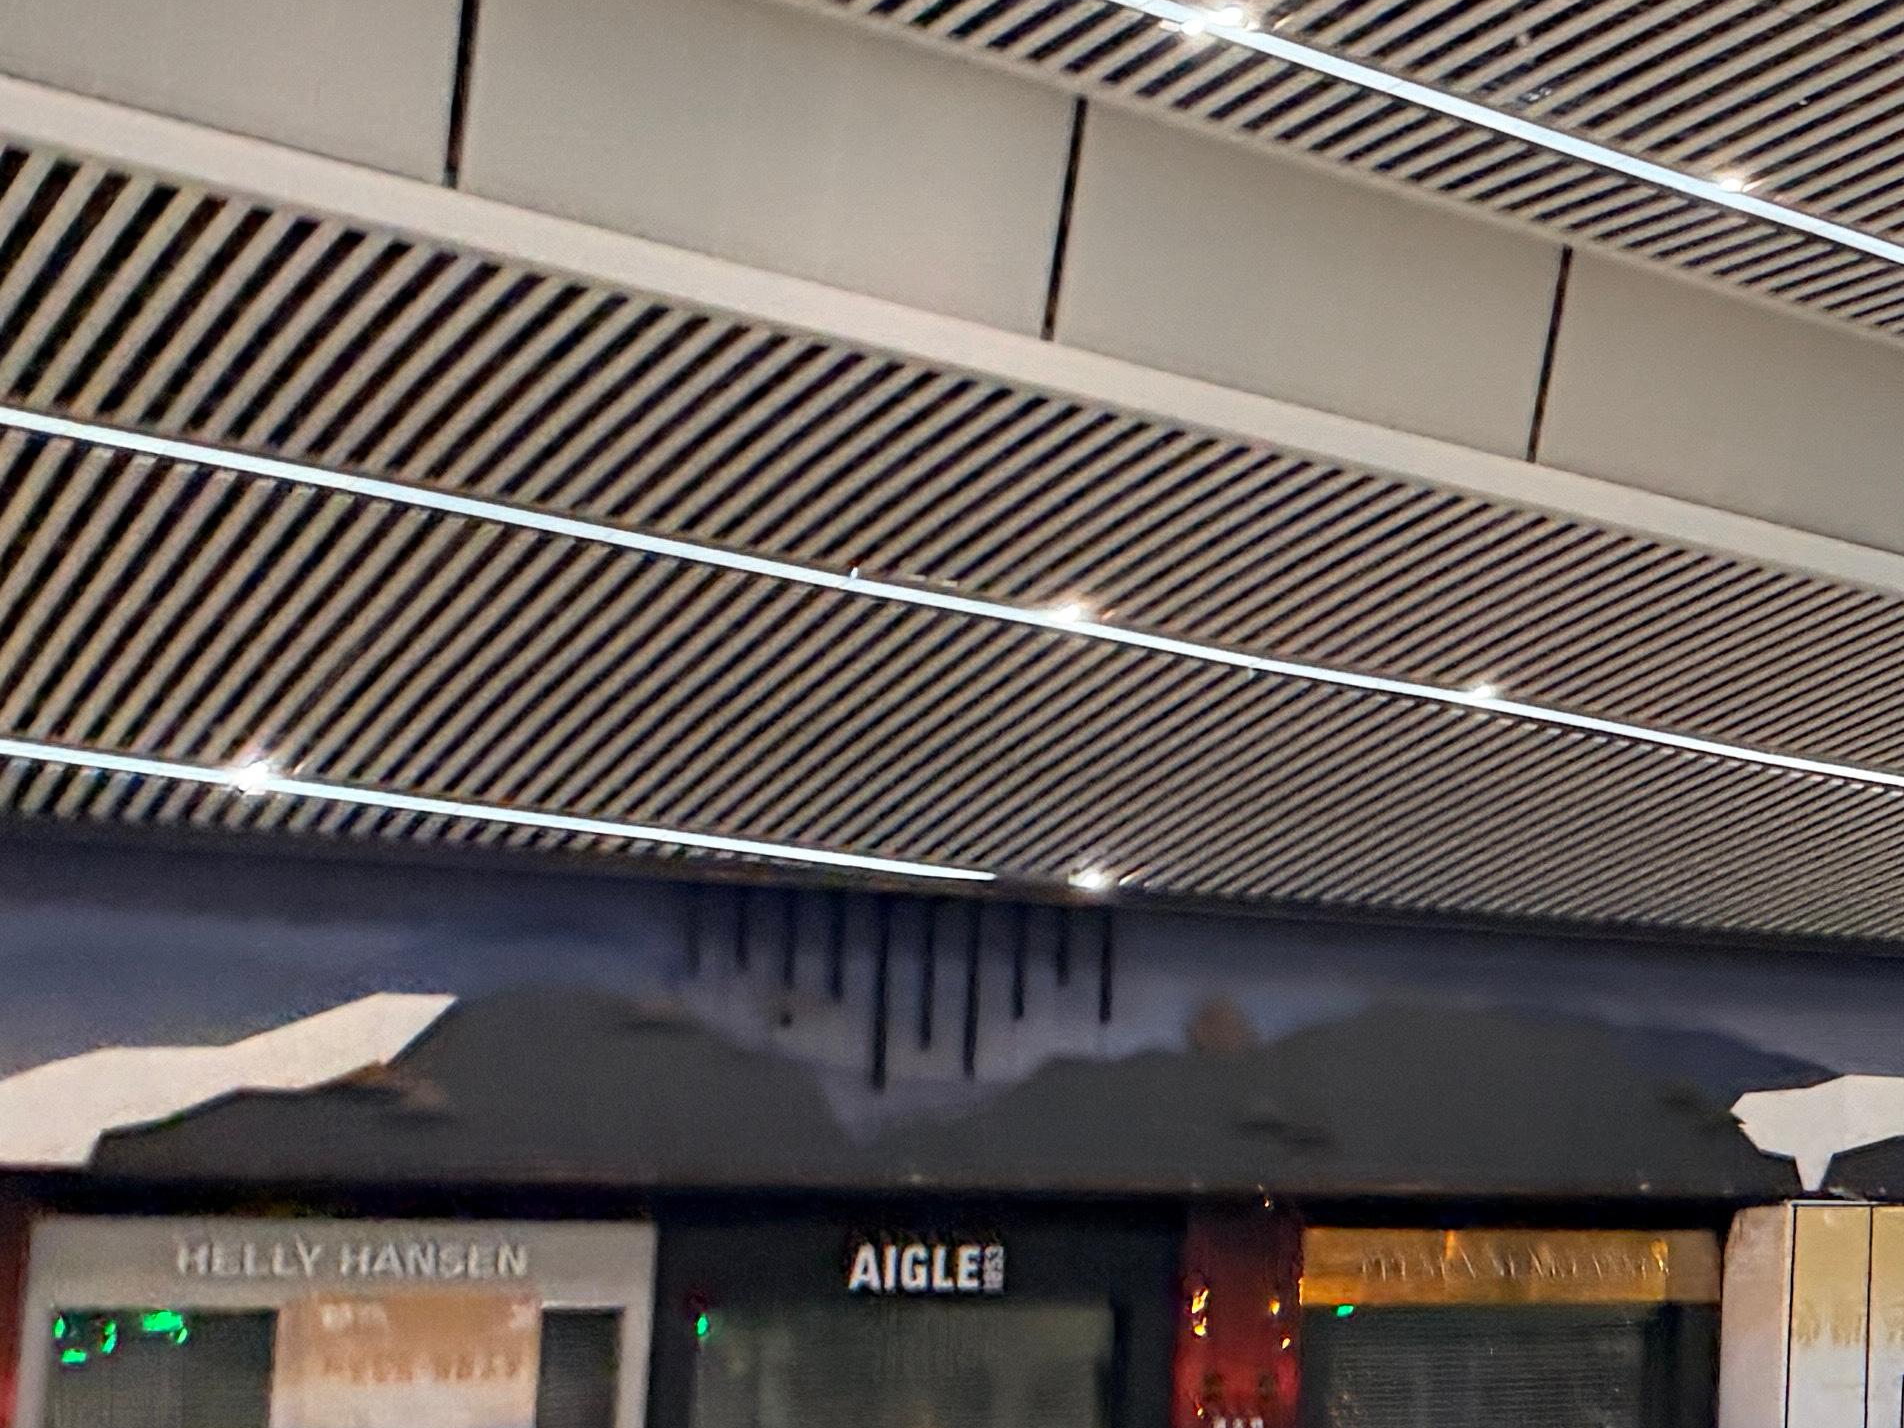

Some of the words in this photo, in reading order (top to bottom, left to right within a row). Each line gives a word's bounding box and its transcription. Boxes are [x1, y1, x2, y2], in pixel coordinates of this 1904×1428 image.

[176, 1238, 322, 1277] HELLY
[339, 1242, 529, 1278] HANSEN
[848, 1241, 981, 1293] AIGLE
